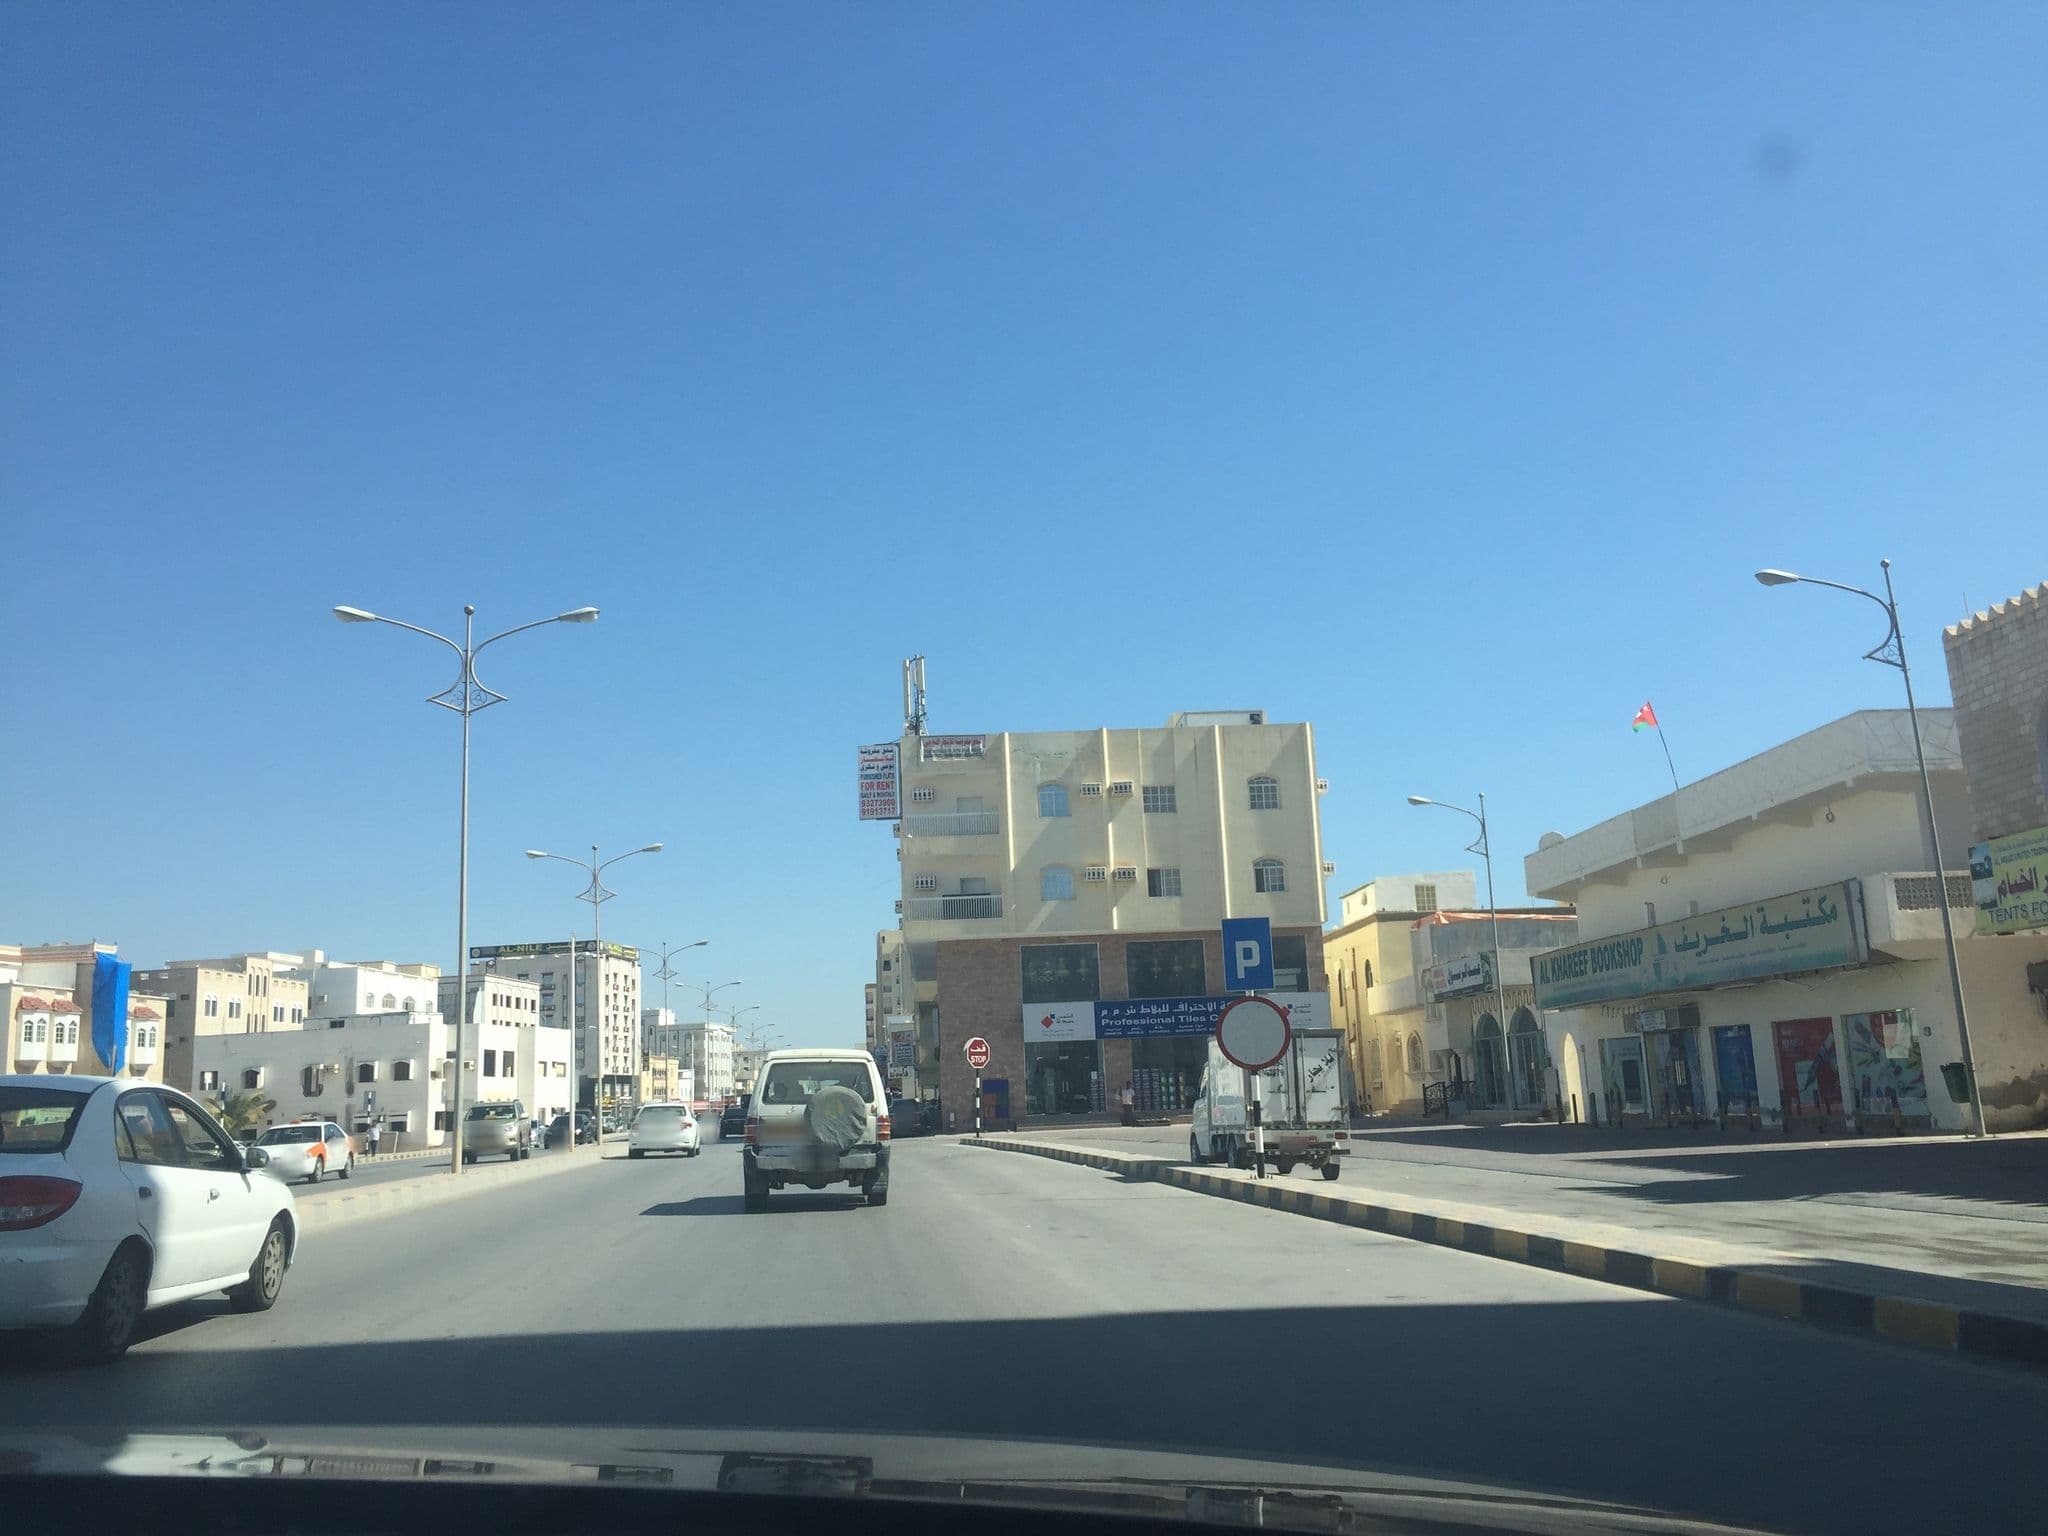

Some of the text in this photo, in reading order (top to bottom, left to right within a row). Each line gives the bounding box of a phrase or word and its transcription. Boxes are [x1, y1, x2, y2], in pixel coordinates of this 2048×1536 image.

[861, 781, 894, 791] FOR RENT
[1756, 895, 1838, 942] مكتبة
[1988, 900, 2048, 924] TENTS FO
[498, 943, 543, 954] AL-NILE
[1235, 940, 1261, 979] P
[1540, 937, 1644, 985] AL KHAREEF BOOKSHOP
[1139, 1003, 1169, 1015] للبلاط
[1101, 1015, 1175, 1027] Professional
[1177, 1013, 1206, 1024] Tiles
[970, 1044, 986, 1052] قف
[970, 1055, 987, 1064] STOP
